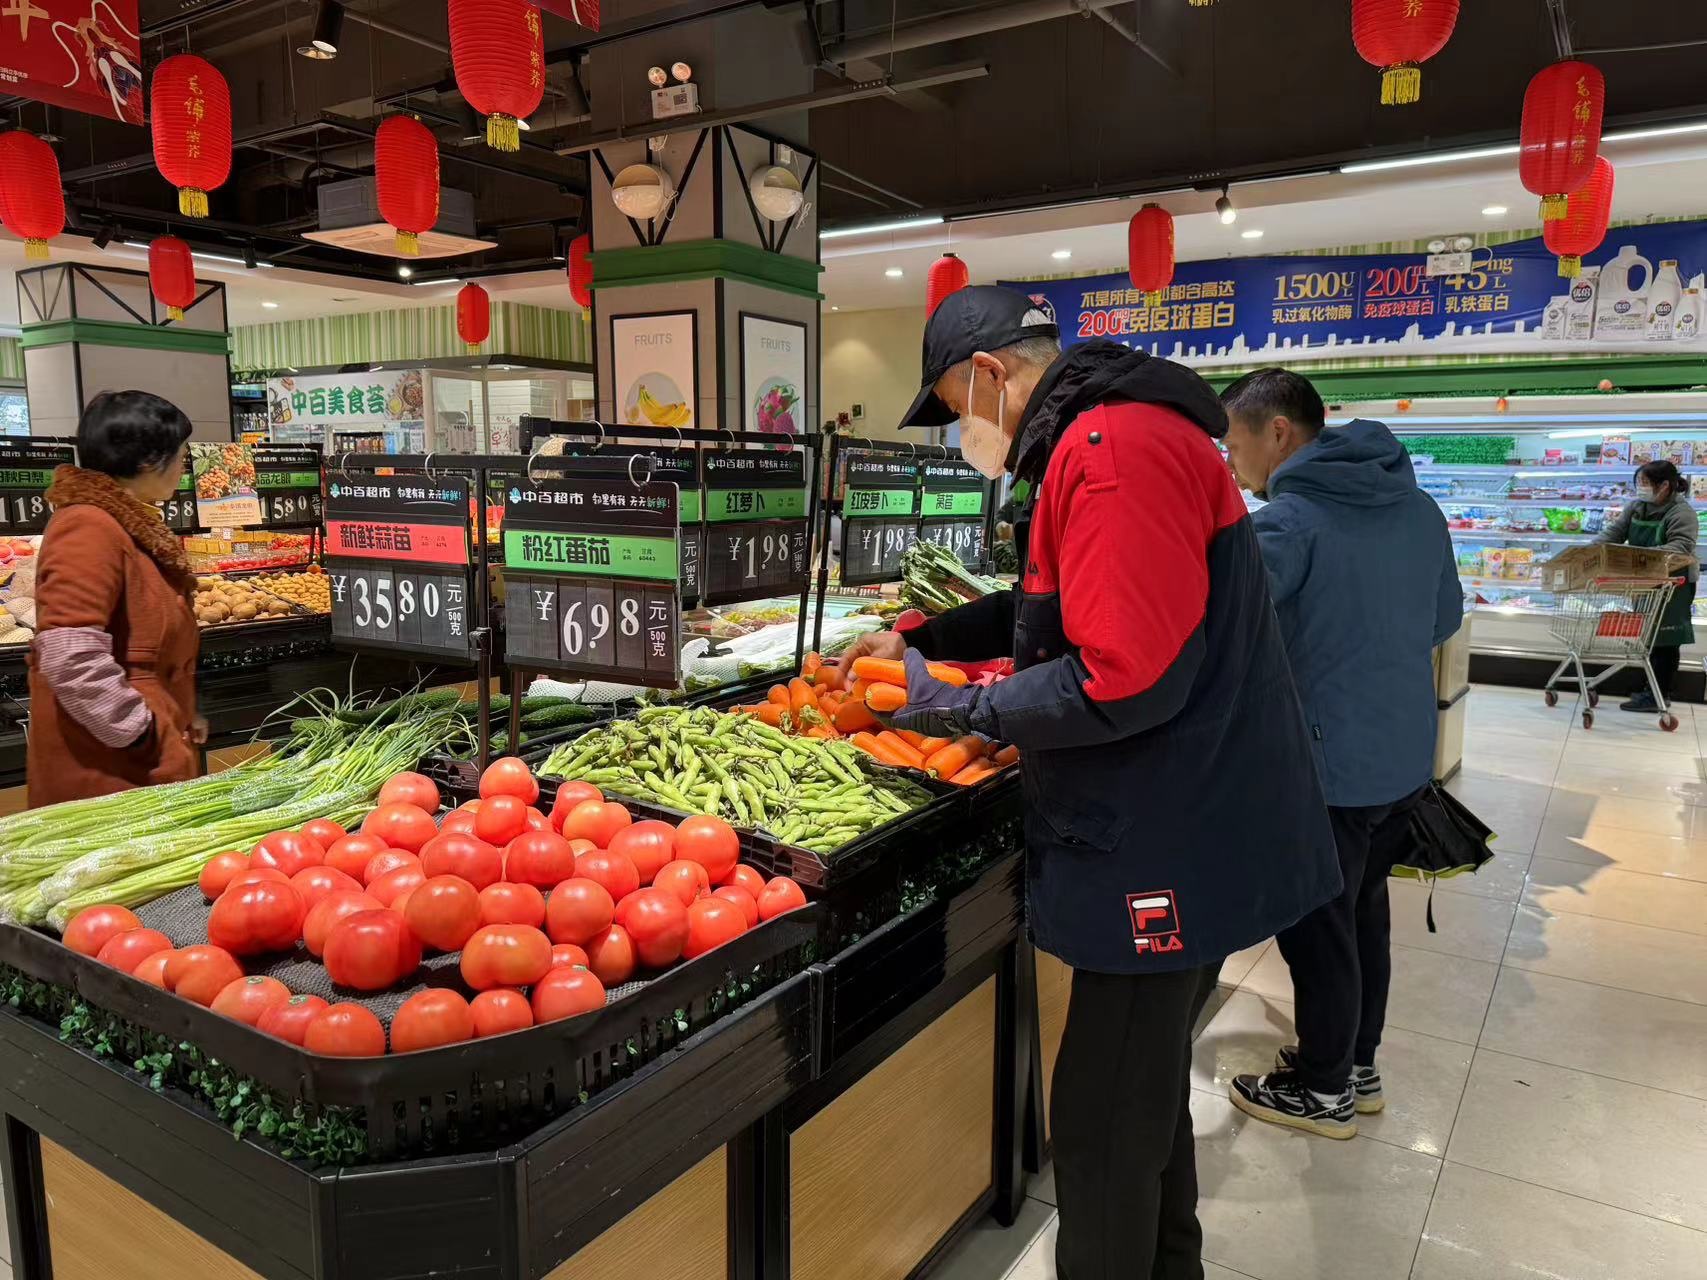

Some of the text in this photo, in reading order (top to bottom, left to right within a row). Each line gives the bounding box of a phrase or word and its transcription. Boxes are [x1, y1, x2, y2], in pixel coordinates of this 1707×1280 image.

[1273, 271, 1341, 301] 1500
[1363, 300, 1434, 318] 免疫球蛋白
[1444, 294, 1510, 313] 乳铁蛋白
[1077, 309, 1123, 338] 200
[1129, 301, 1235, 334] 免疫球蛋白
[1271, 305, 1353, 324] 乳过氧化物酶
[633, 332, 672, 347] FRUITS
[760, 337, 791, 351] FRUITS
[291, 384, 385, 417] 中百美食荟
[716, 458, 755, 469] 中百超市
[340, 486, 391, 499] 中百超市
[522, 490, 584, 505] 中百超市
[726, 491, 766, 514] 红萝卜
[851, 491, 889, 511] 红皮萝卜
[340, 523, 412, 551] 新鲜蒜苗
[522, 535, 611, 566] 粉红番茄
[1134, 934, 1184, 954] FILA
